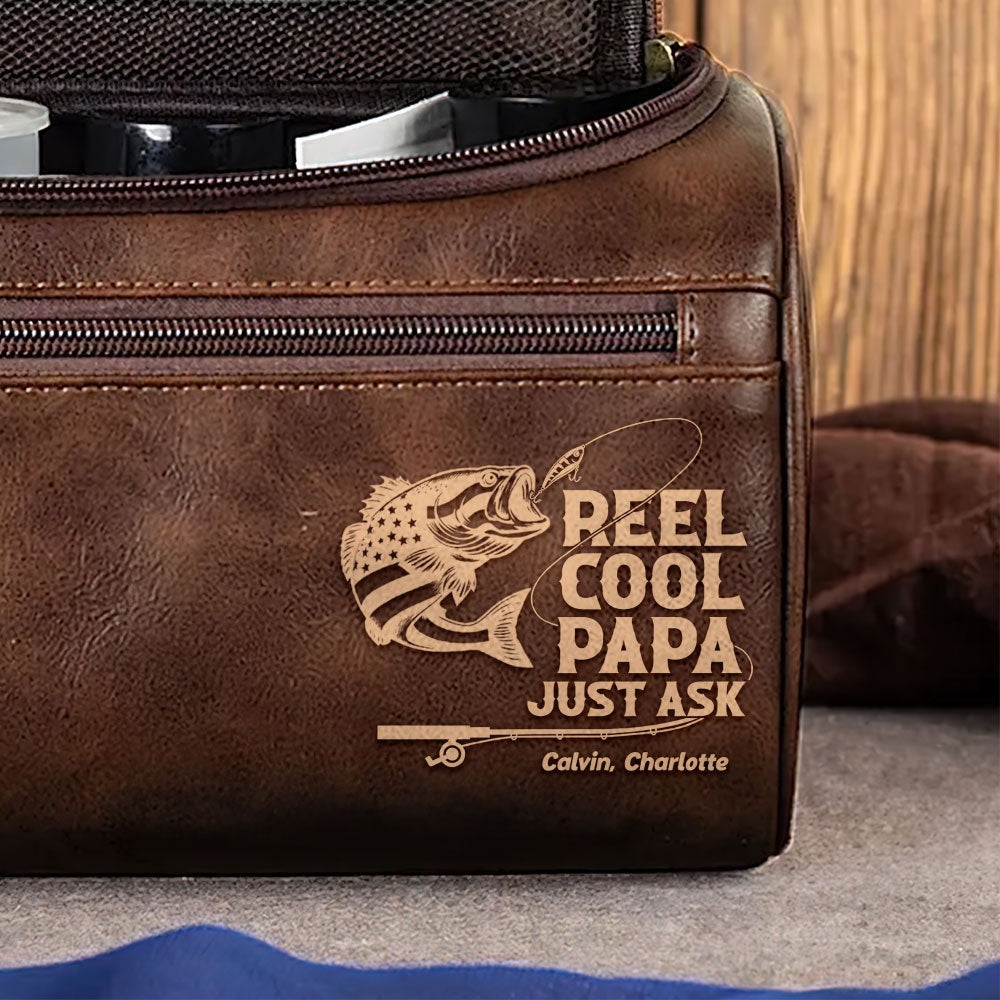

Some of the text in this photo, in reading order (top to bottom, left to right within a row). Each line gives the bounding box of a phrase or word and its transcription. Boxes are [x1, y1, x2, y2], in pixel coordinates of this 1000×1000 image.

[562, 489, 747, 547] REEL
[559, 552, 745, 610] COOL
[558, 616, 742, 674] PAPA
[527, 681, 746, 717] JUST ASK
[542, 751, 729, 772] Calvin, Charlotte
